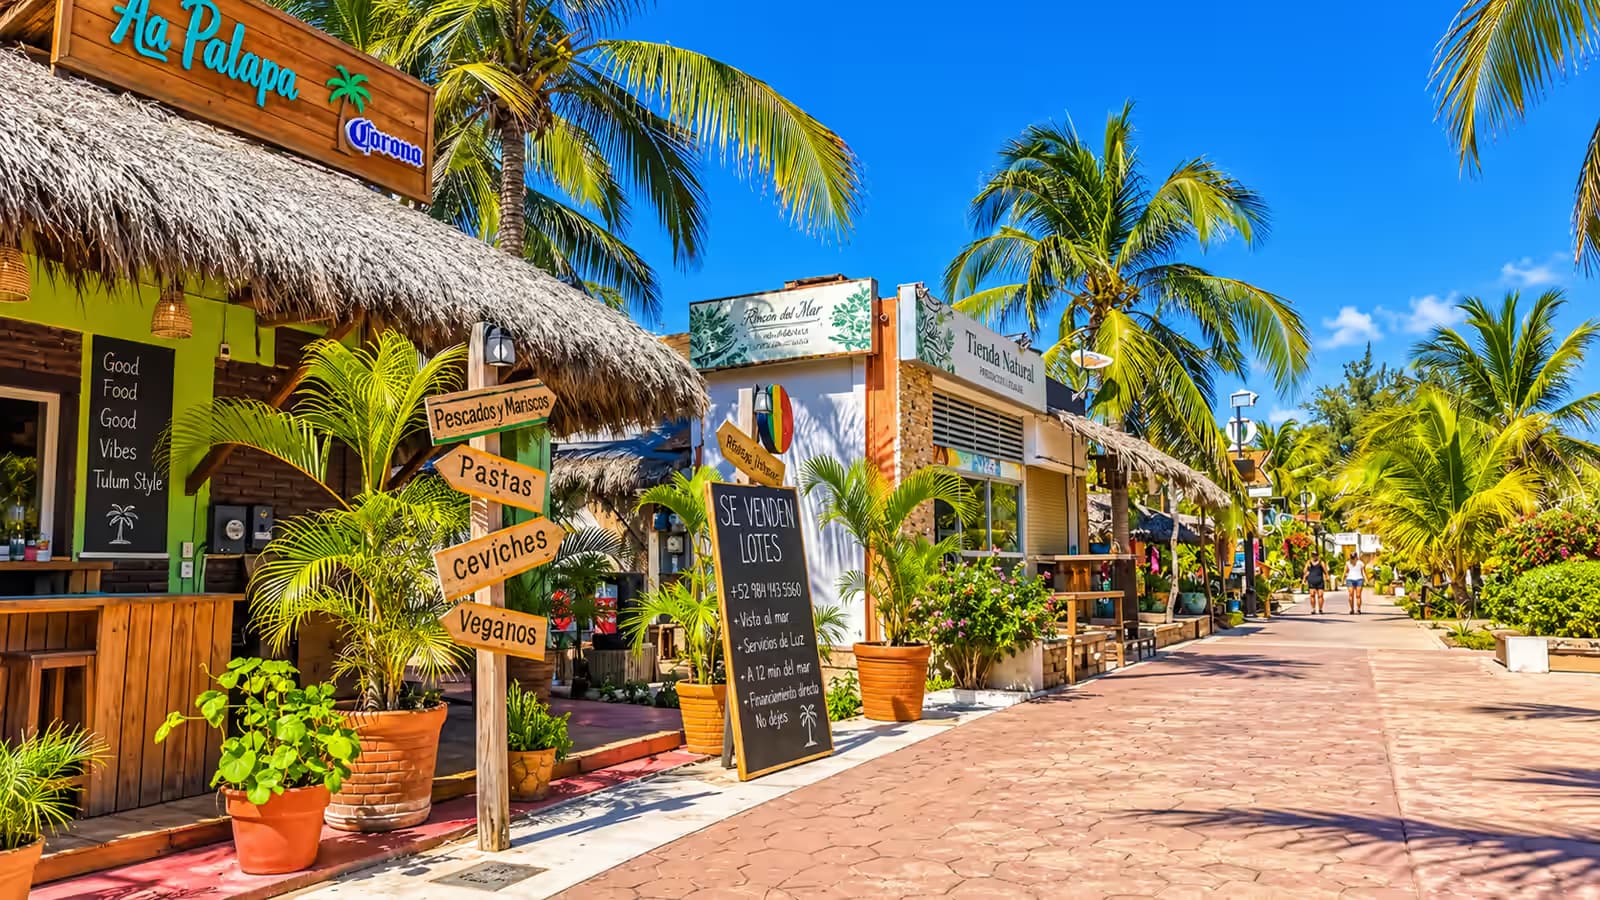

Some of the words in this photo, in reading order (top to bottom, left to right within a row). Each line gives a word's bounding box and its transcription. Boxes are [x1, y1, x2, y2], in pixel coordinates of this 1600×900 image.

[181, 0, 299, 107] Palapa
[345, 117, 424, 168] Corona
[780, 305, 796, 321] del
[796, 298, 823, 319] Mar
[103, 351, 140, 376] Good
[966, 330, 1000, 367] Tienda
[1002, 349, 1035, 383] Natural
[103, 378, 138, 401] Food
[100, 407, 137, 430] Good
[434, 402, 496, 430] Pescados
[496, 404, 504, 422] y
[504, 394, 550, 417] Mariscos
[99, 438, 137, 461] Vibes
[93, 469, 130, 489] Tulum
[134, 472, 163, 496] Style
[460, 455, 532, 497] Pastas
[720, 494, 741, 527] SE
[743, 496, 796, 529] VENDEN
[453, 529, 547, 581] ceviches
[739, 532, 782, 563] LOTES
[730, 583, 750, 599] +52
[750, 582, 766, 599] 984
[460, 608, 537, 646] Veganos
[739, 609, 761, 628] Vista
[764, 608, 773, 625] al
[774, 612, 790, 624] mar
[743, 636, 778, 654] Servicios
[779, 631, 789, 649] de
[789, 631, 805, 647] Luz
[747, 666, 755, 683] A
[755, 664, 766, 681] 12
[767, 664, 781, 679] min
[783, 658, 794, 677] del
[796, 662, 811, 674] mar
[755, 712, 767, 729] No
[768, 709, 789, 730] dejes
